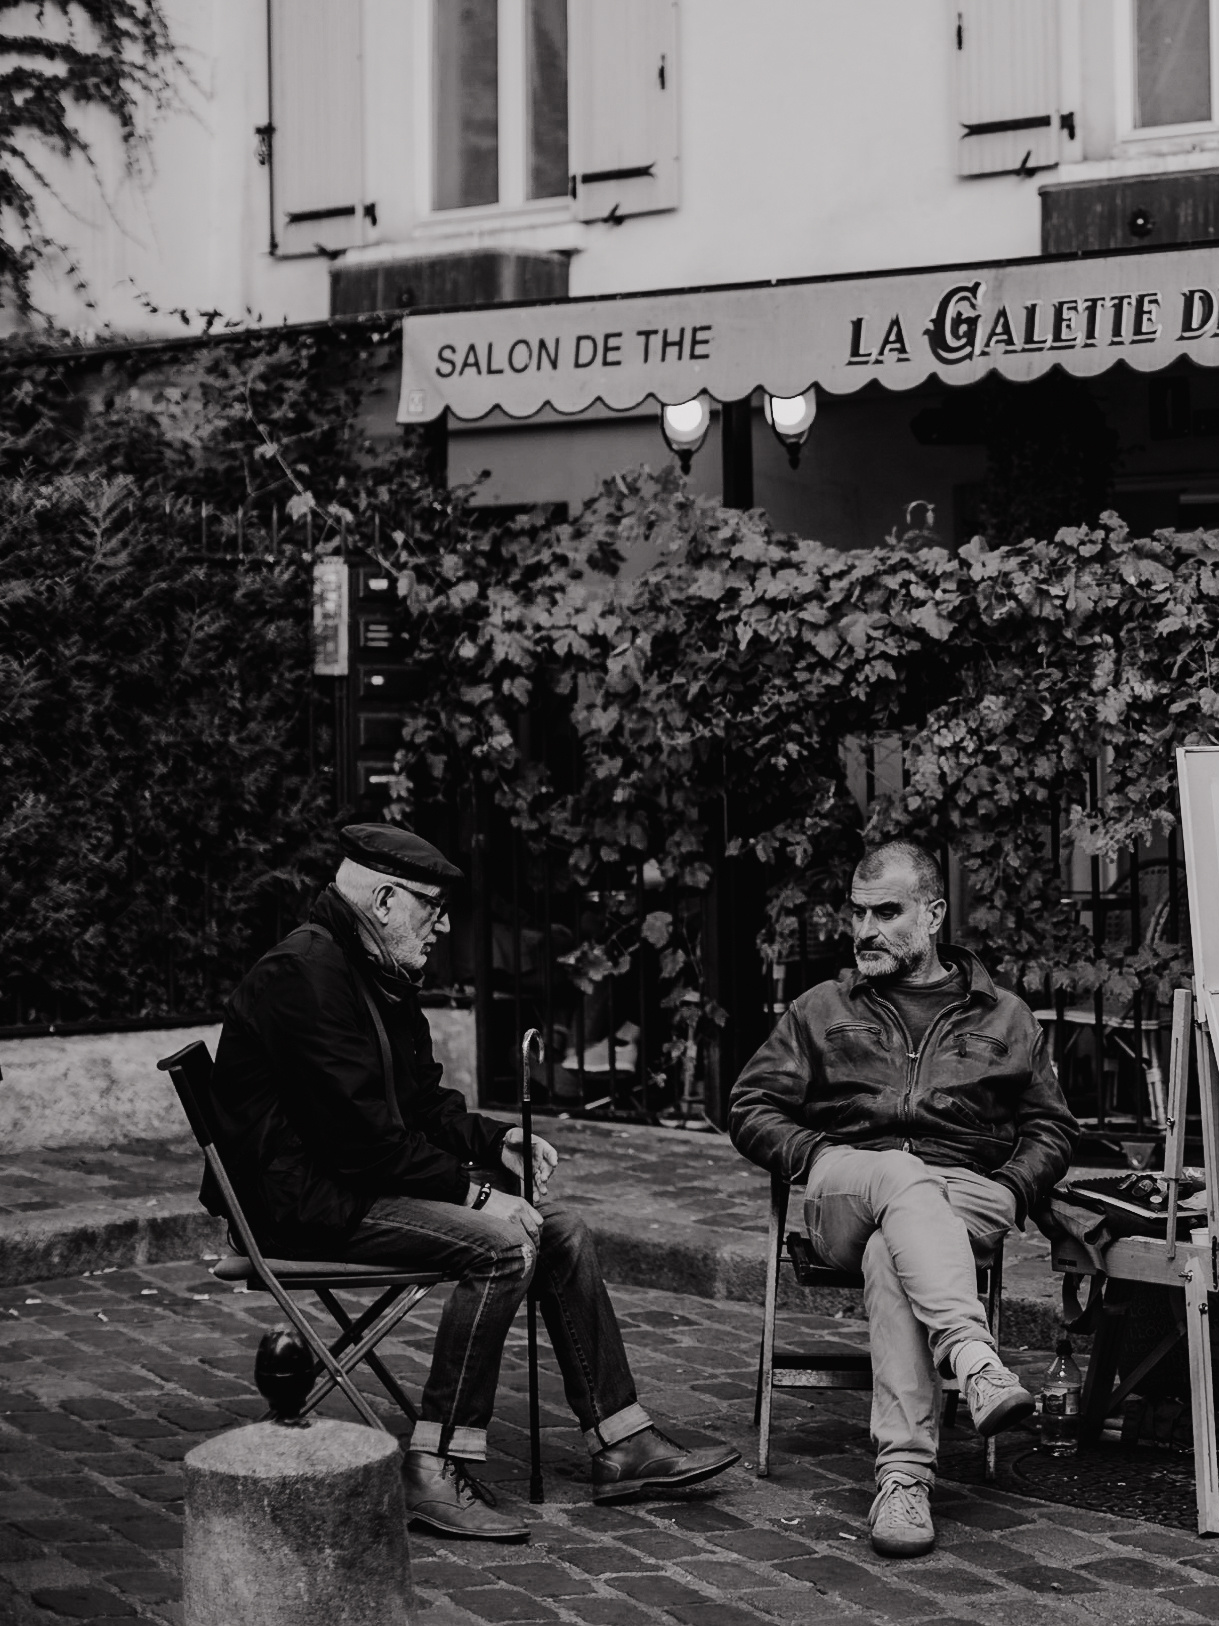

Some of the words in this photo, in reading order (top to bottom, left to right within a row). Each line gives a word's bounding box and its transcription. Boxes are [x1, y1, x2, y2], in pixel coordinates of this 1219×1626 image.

[434, 336, 561, 379] SALON
[573, 332, 623, 370] DE
[635, 324, 713, 364] THE
[844, 312, 912, 366] LA
[922, 280, 1162, 365] GALETTE
